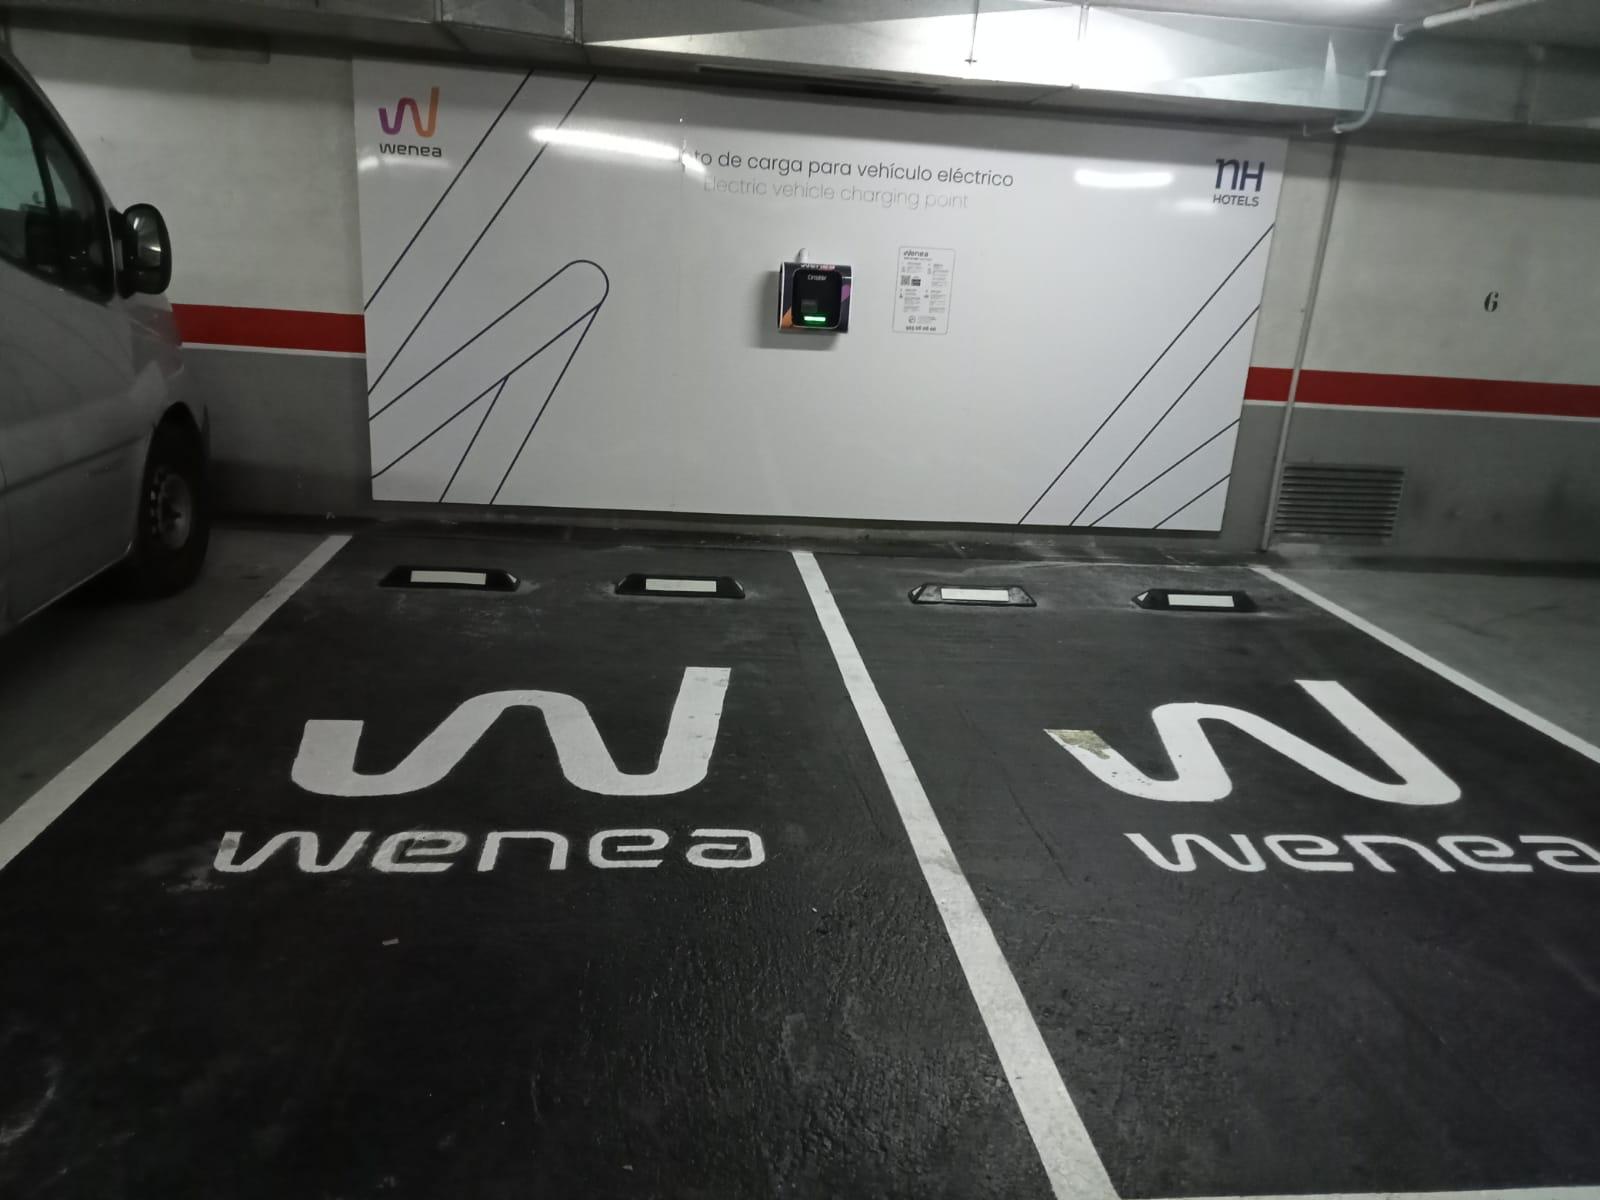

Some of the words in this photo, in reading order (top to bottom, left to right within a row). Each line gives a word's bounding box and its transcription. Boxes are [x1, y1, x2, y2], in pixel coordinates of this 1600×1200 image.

[379, 143, 442, 158] wenea
[718, 151, 742, 169] de
[747, 155, 802, 176] carga
[808, 159, 852, 178] para
[857, 162, 932, 182] vehículo
[937, 166, 1014, 187] eléctrico
[772, 180, 835, 200] vehicle
[840, 185, 920, 211] charging
[925, 191, 969, 210] point
[1212, 194, 1261, 207] HOTELS
[1484, 291, 1499, 313] 6
[213, 828, 766, 873] wenea
[1122, 832, 1600, 873] wenea
